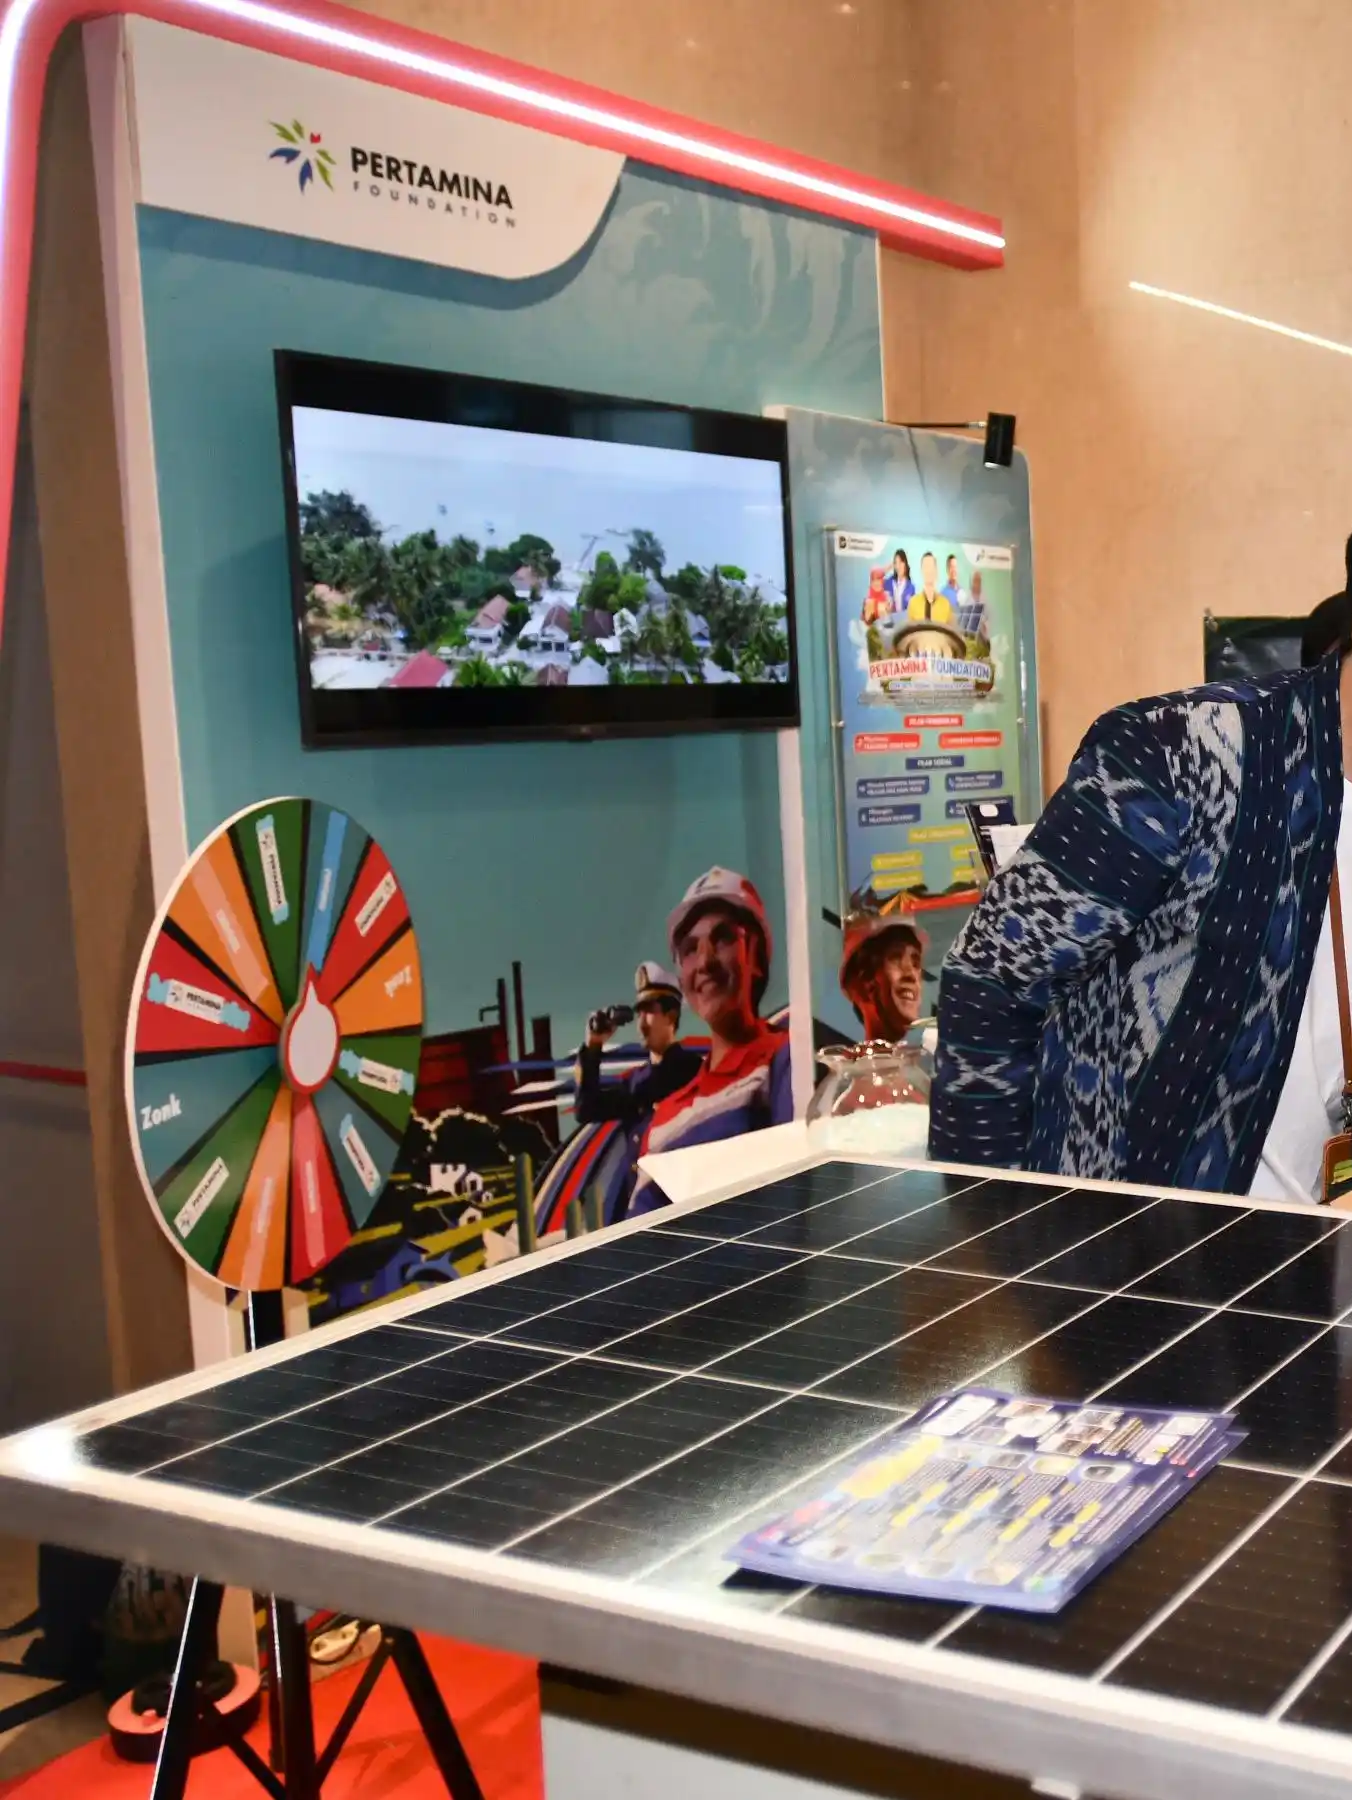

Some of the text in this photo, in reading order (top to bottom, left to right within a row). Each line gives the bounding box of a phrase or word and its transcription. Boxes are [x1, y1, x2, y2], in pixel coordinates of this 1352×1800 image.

[351, 146, 513, 210] PERTAMINA
[353, 180, 516, 229] FOUNDATION
[869, 658, 928, 679] PERTAMINA
[141, 1093, 182, 1131] Zonk
